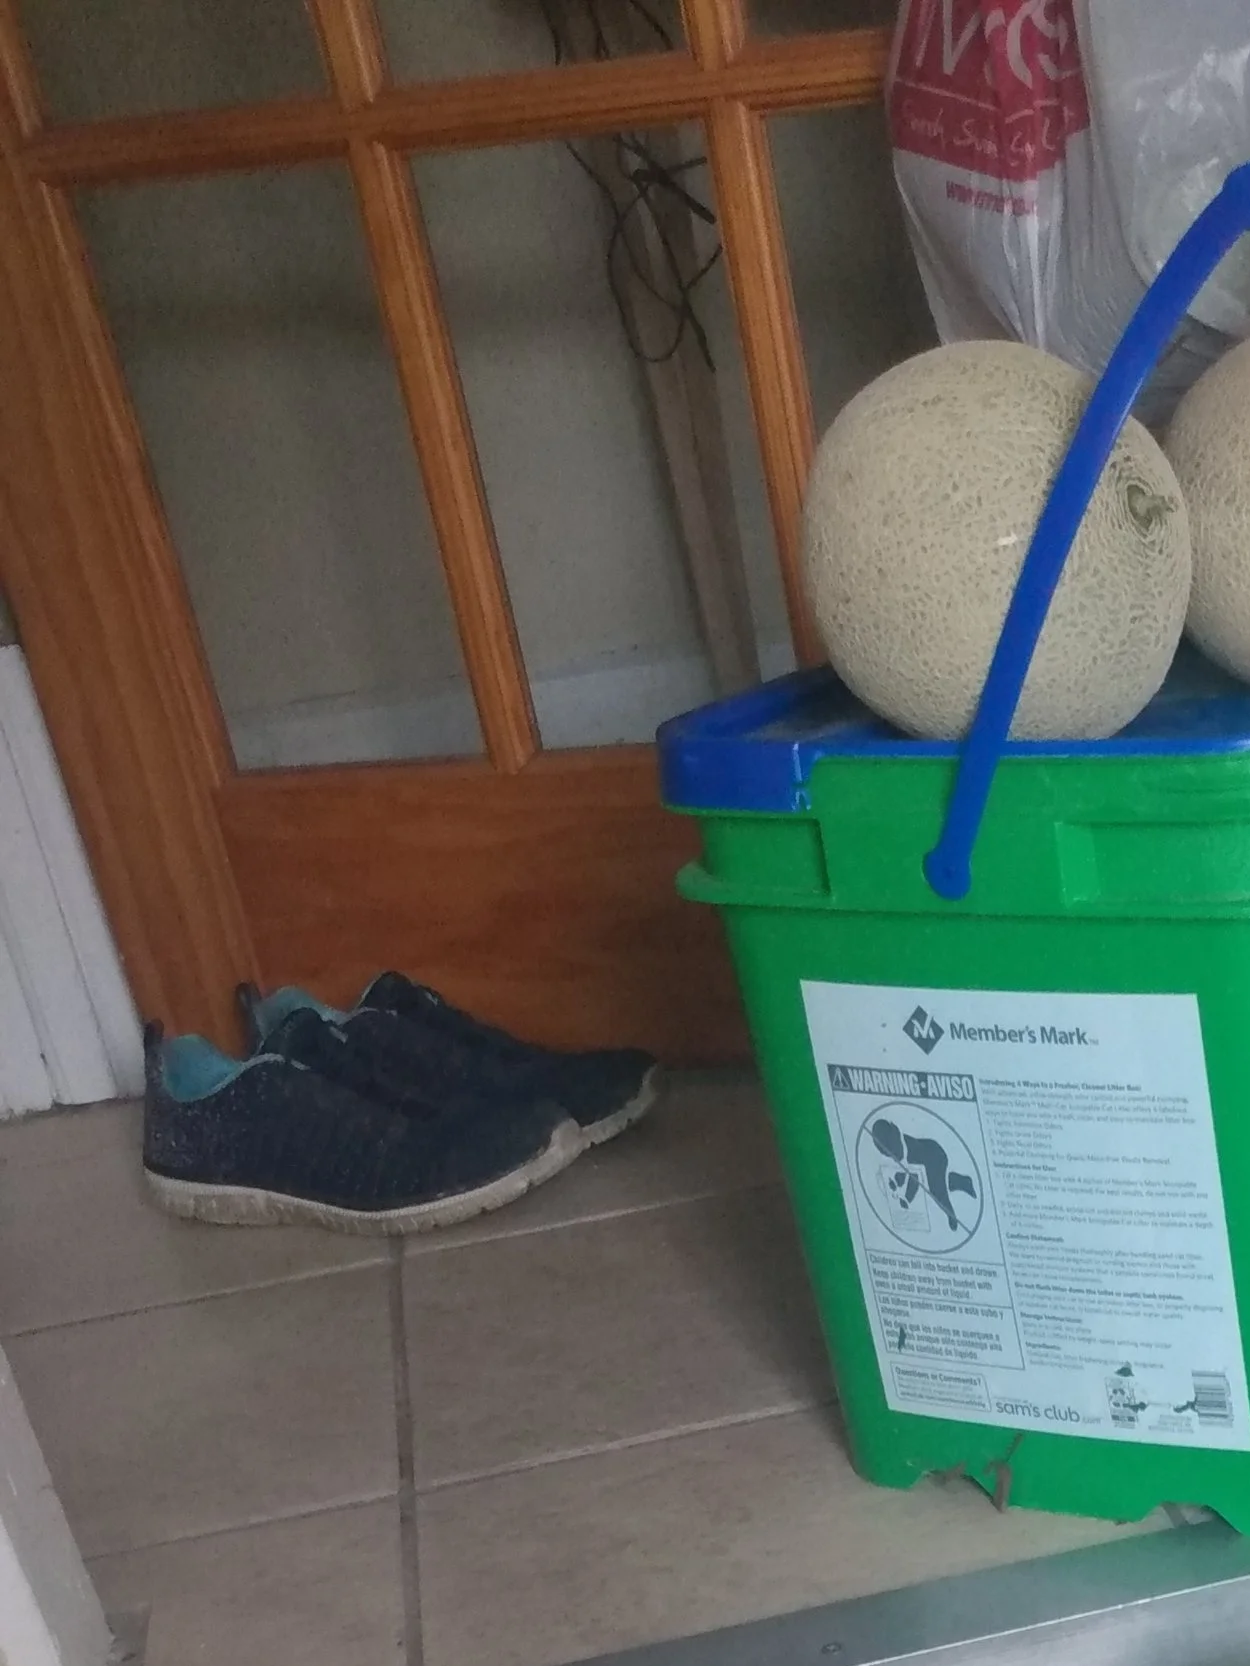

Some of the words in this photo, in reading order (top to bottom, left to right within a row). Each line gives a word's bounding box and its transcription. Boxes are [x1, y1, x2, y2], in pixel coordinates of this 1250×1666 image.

[950, 1022, 1037, 1044] Member's
[1041, 1025, 1089, 1046] Mark
[847, 1068, 921, 1096] WARNING
[926, 1075, 975, 1099] AVISO
[996, 1401, 1041, 1419] sam's
[1044, 1405, 1081, 1424] club
